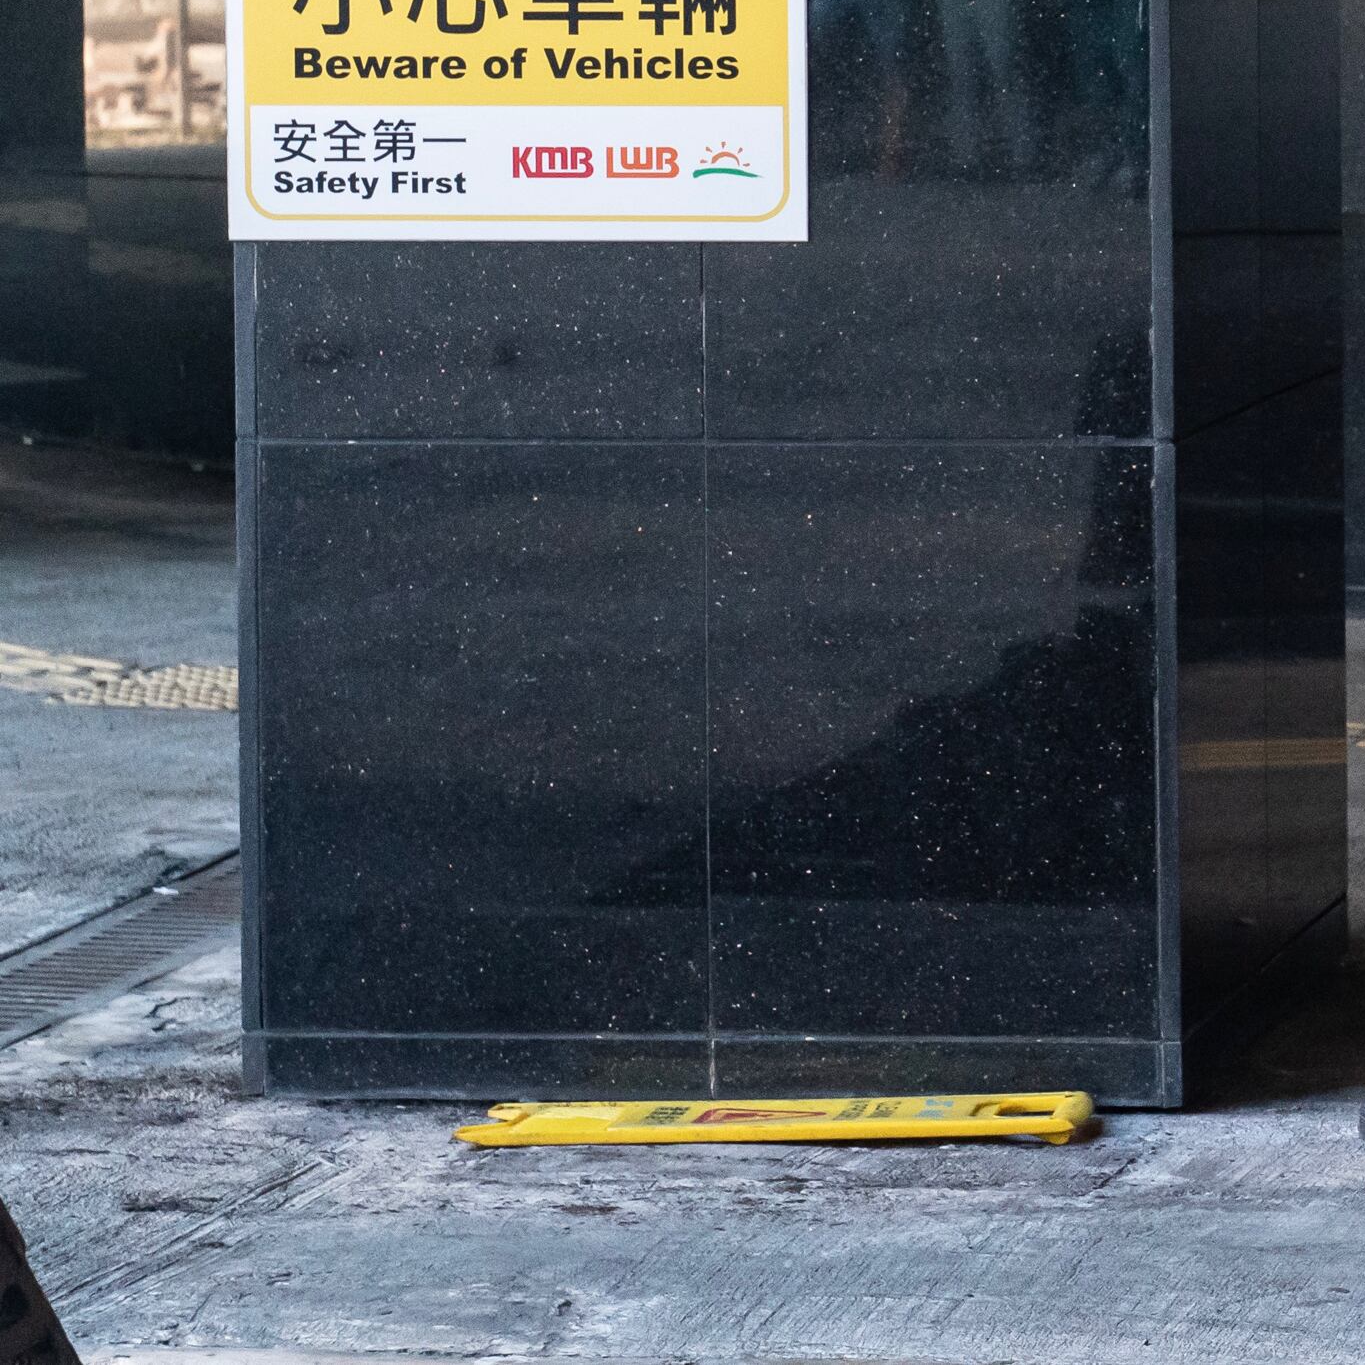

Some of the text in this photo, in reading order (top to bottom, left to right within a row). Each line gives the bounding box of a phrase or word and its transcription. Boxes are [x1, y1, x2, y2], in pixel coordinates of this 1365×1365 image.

[294, 47, 739, 80] Beware of Vehicles
[273, 119, 467, 163] 安全第一
[512, 146, 681, 179] KMB LWB
[273, 170, 467, 200] Safety First
